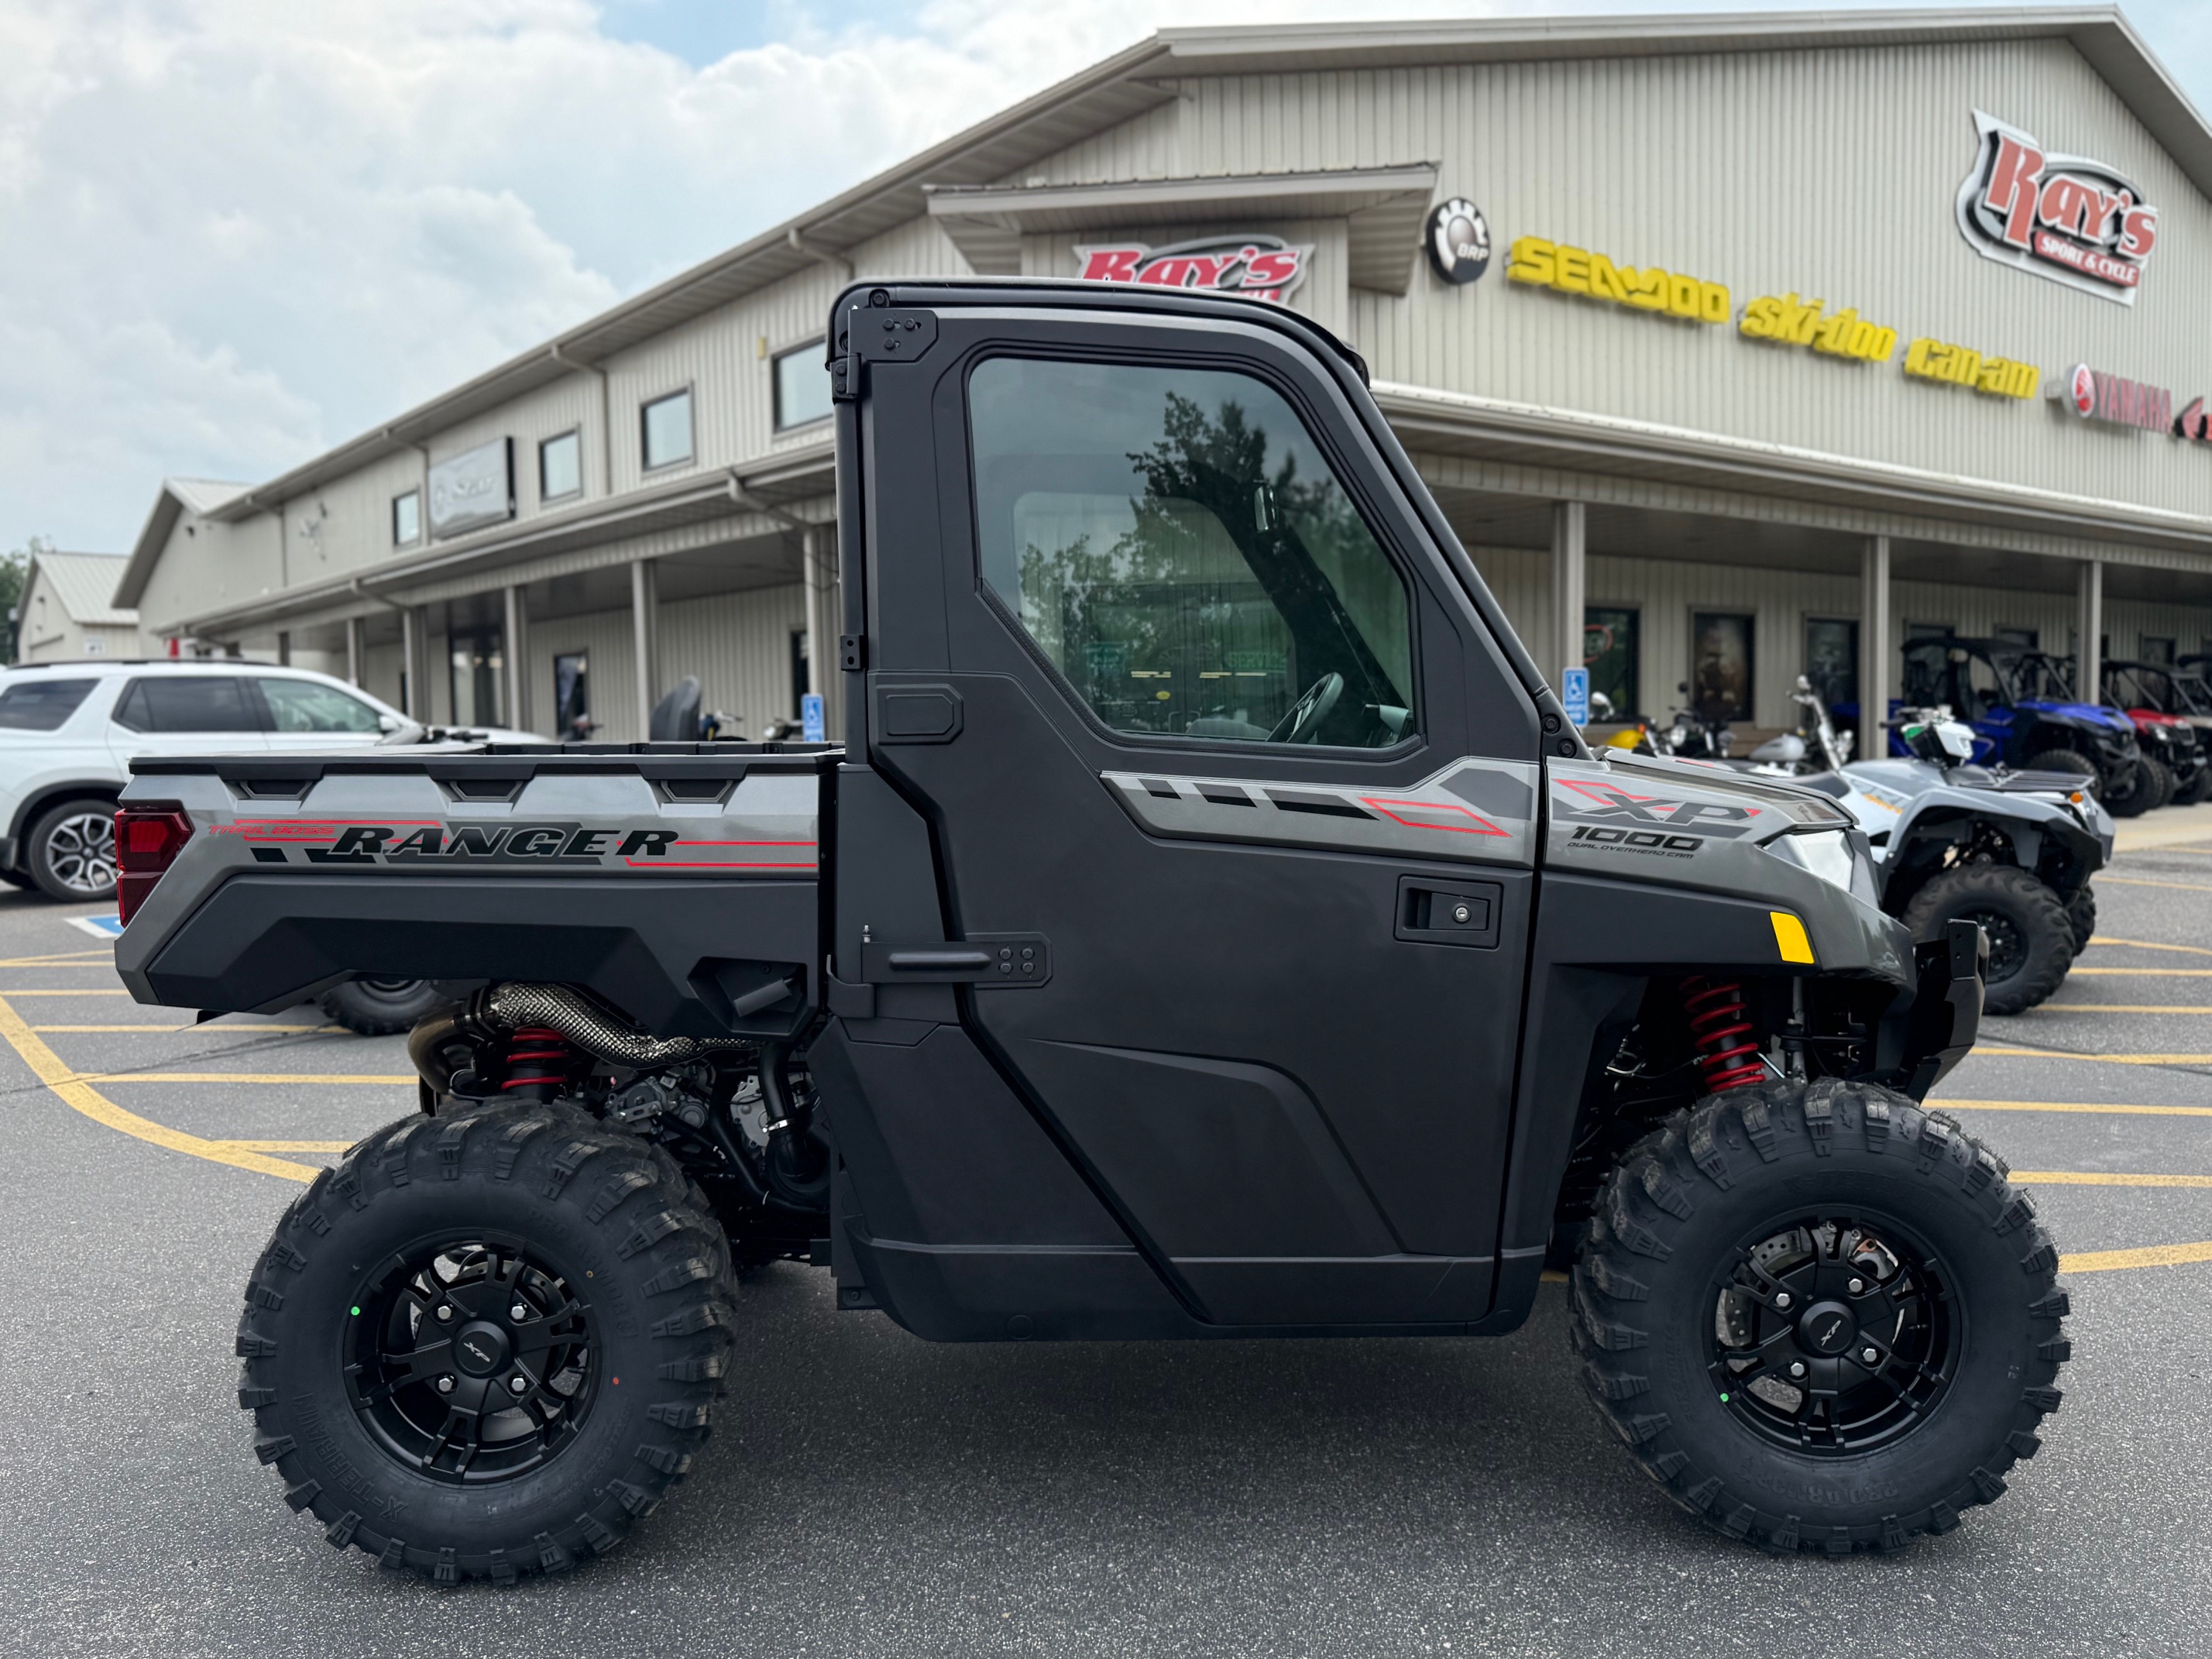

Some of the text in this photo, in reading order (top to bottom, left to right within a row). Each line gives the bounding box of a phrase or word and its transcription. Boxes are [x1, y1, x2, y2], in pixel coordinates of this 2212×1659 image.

[1457, 243, 1489, 261] BRP
[2041, 235, 2138, 283] SPORT & CYCLE
[2094, 371, 2172, 434] YAMAHA
[1570, 792, 1751, 826] XP
[208, 825, 335, 836] TRAIL BOSS
[327, 826, 680, 857] RANGER
[1571, 826, 1704, 851] 1000
[1568, 841, 1695, 859] DUAL OVERHEAD CAM
[1820, 1319, 1842, 1348] XP
[462, 1341, 491, 1363] XP
